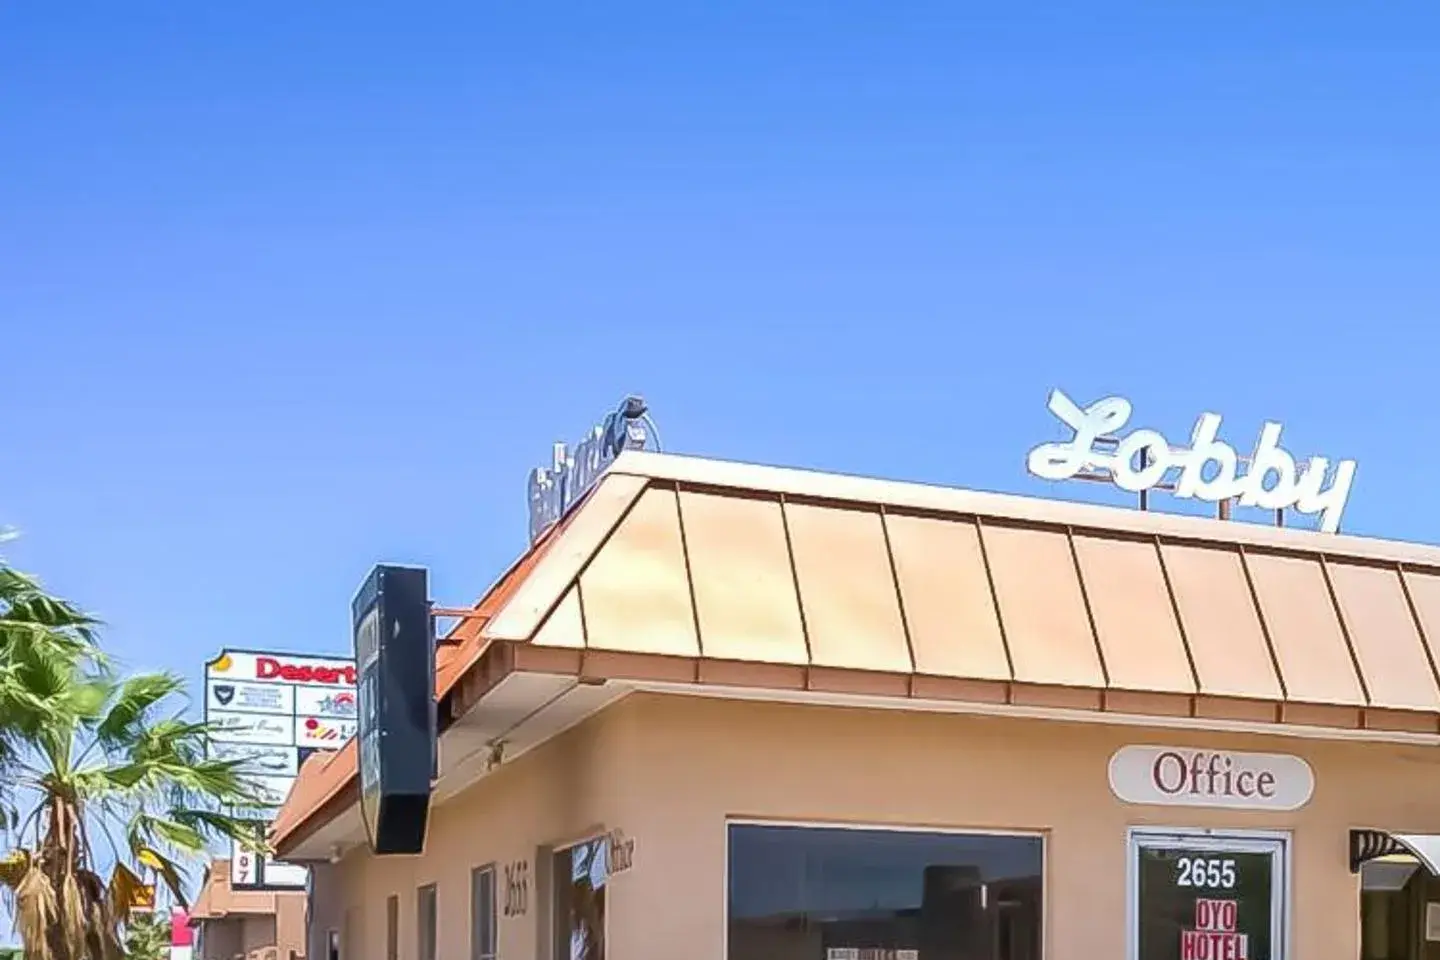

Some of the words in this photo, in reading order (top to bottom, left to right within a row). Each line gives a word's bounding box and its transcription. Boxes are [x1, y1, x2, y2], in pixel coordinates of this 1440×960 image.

[1026, 388, 1357, 534] Lobby
[256, 658, 357, 684] Desert
[1153, 751, 1276, 797] Office
[1177, 858, 1236, 888] 2655
[1197, 900, 1236, 930] OYO
